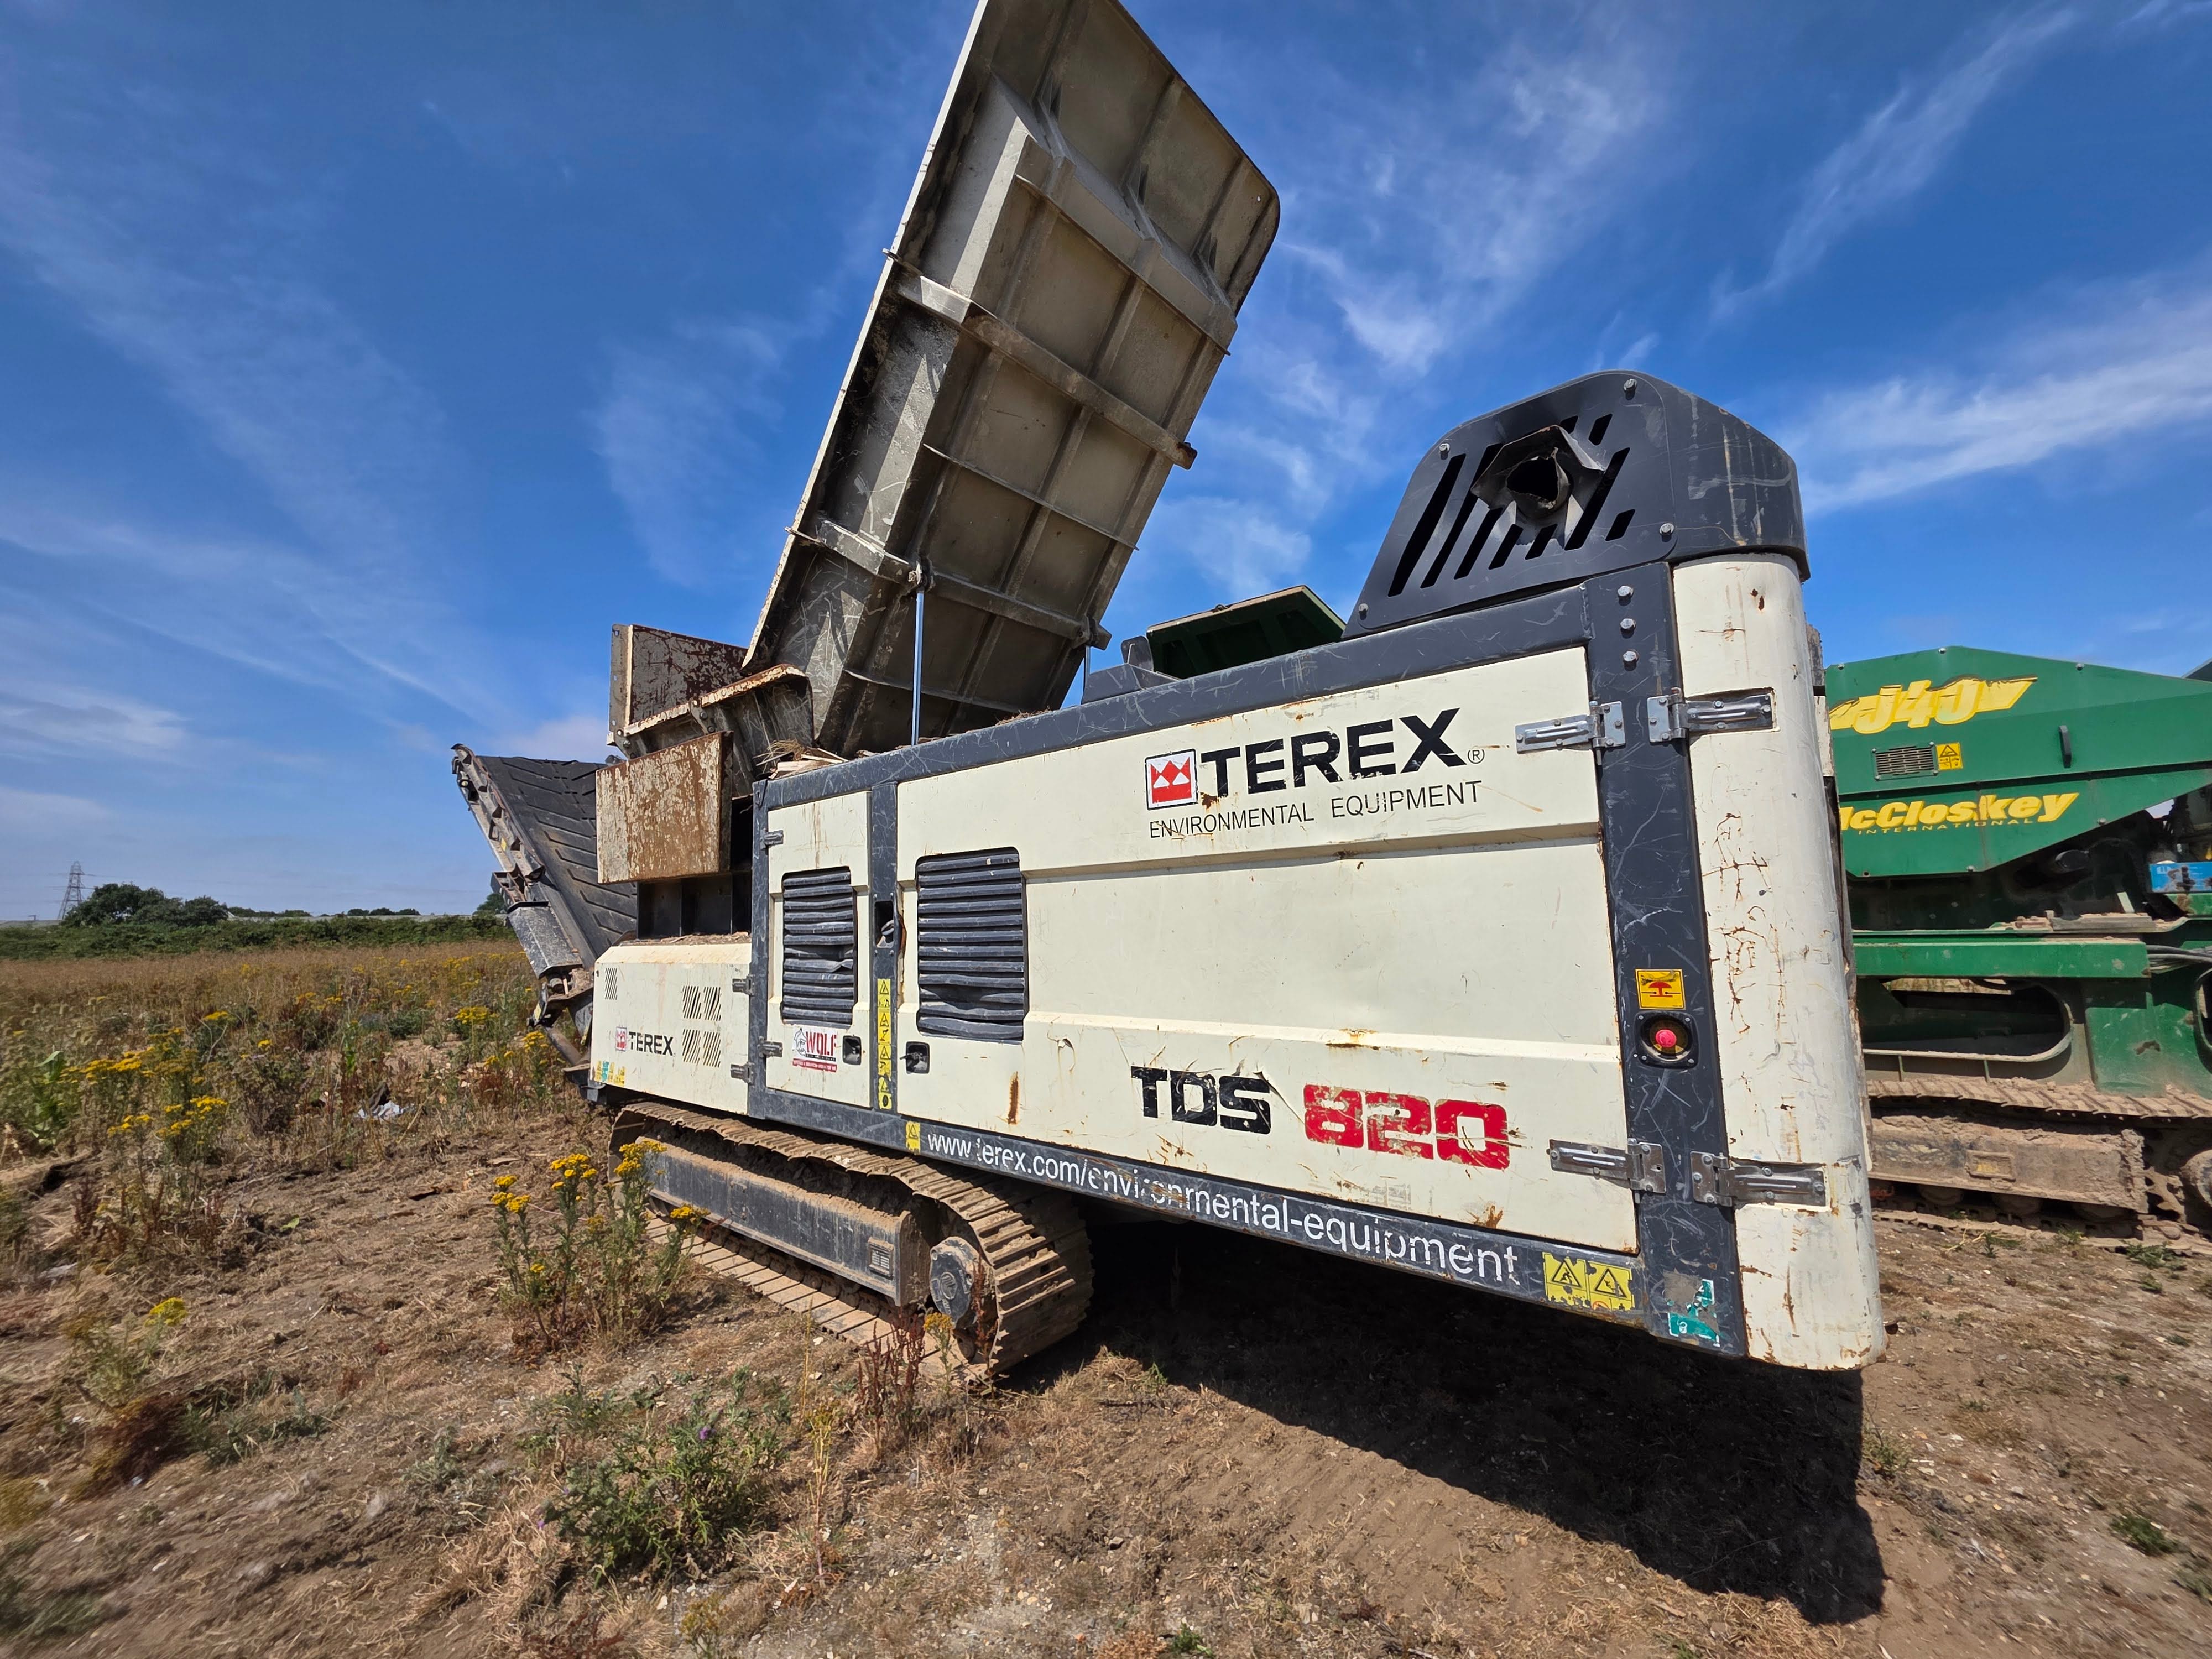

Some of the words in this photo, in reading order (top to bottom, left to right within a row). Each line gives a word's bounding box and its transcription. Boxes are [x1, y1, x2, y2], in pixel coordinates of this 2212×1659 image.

[1853, 677, 1986, 734] J40
[1150, 802, 1314, 838] ENVIRONMENTAL
[1332, 780, 1482, 818] EQUIPMENT
[1858, 818, 2034, 835] INTERNATIONAL
[629, 1031, 674, 1056] TEREX
[806, 1031, 837, 1056] WOLF
[1130, 1066, 1272, 1135] TDS
[1303, 1084, 1510, 1169] 820
[927, 1132, 1519, 1285] wwwterex.com/envionmental-equipment
